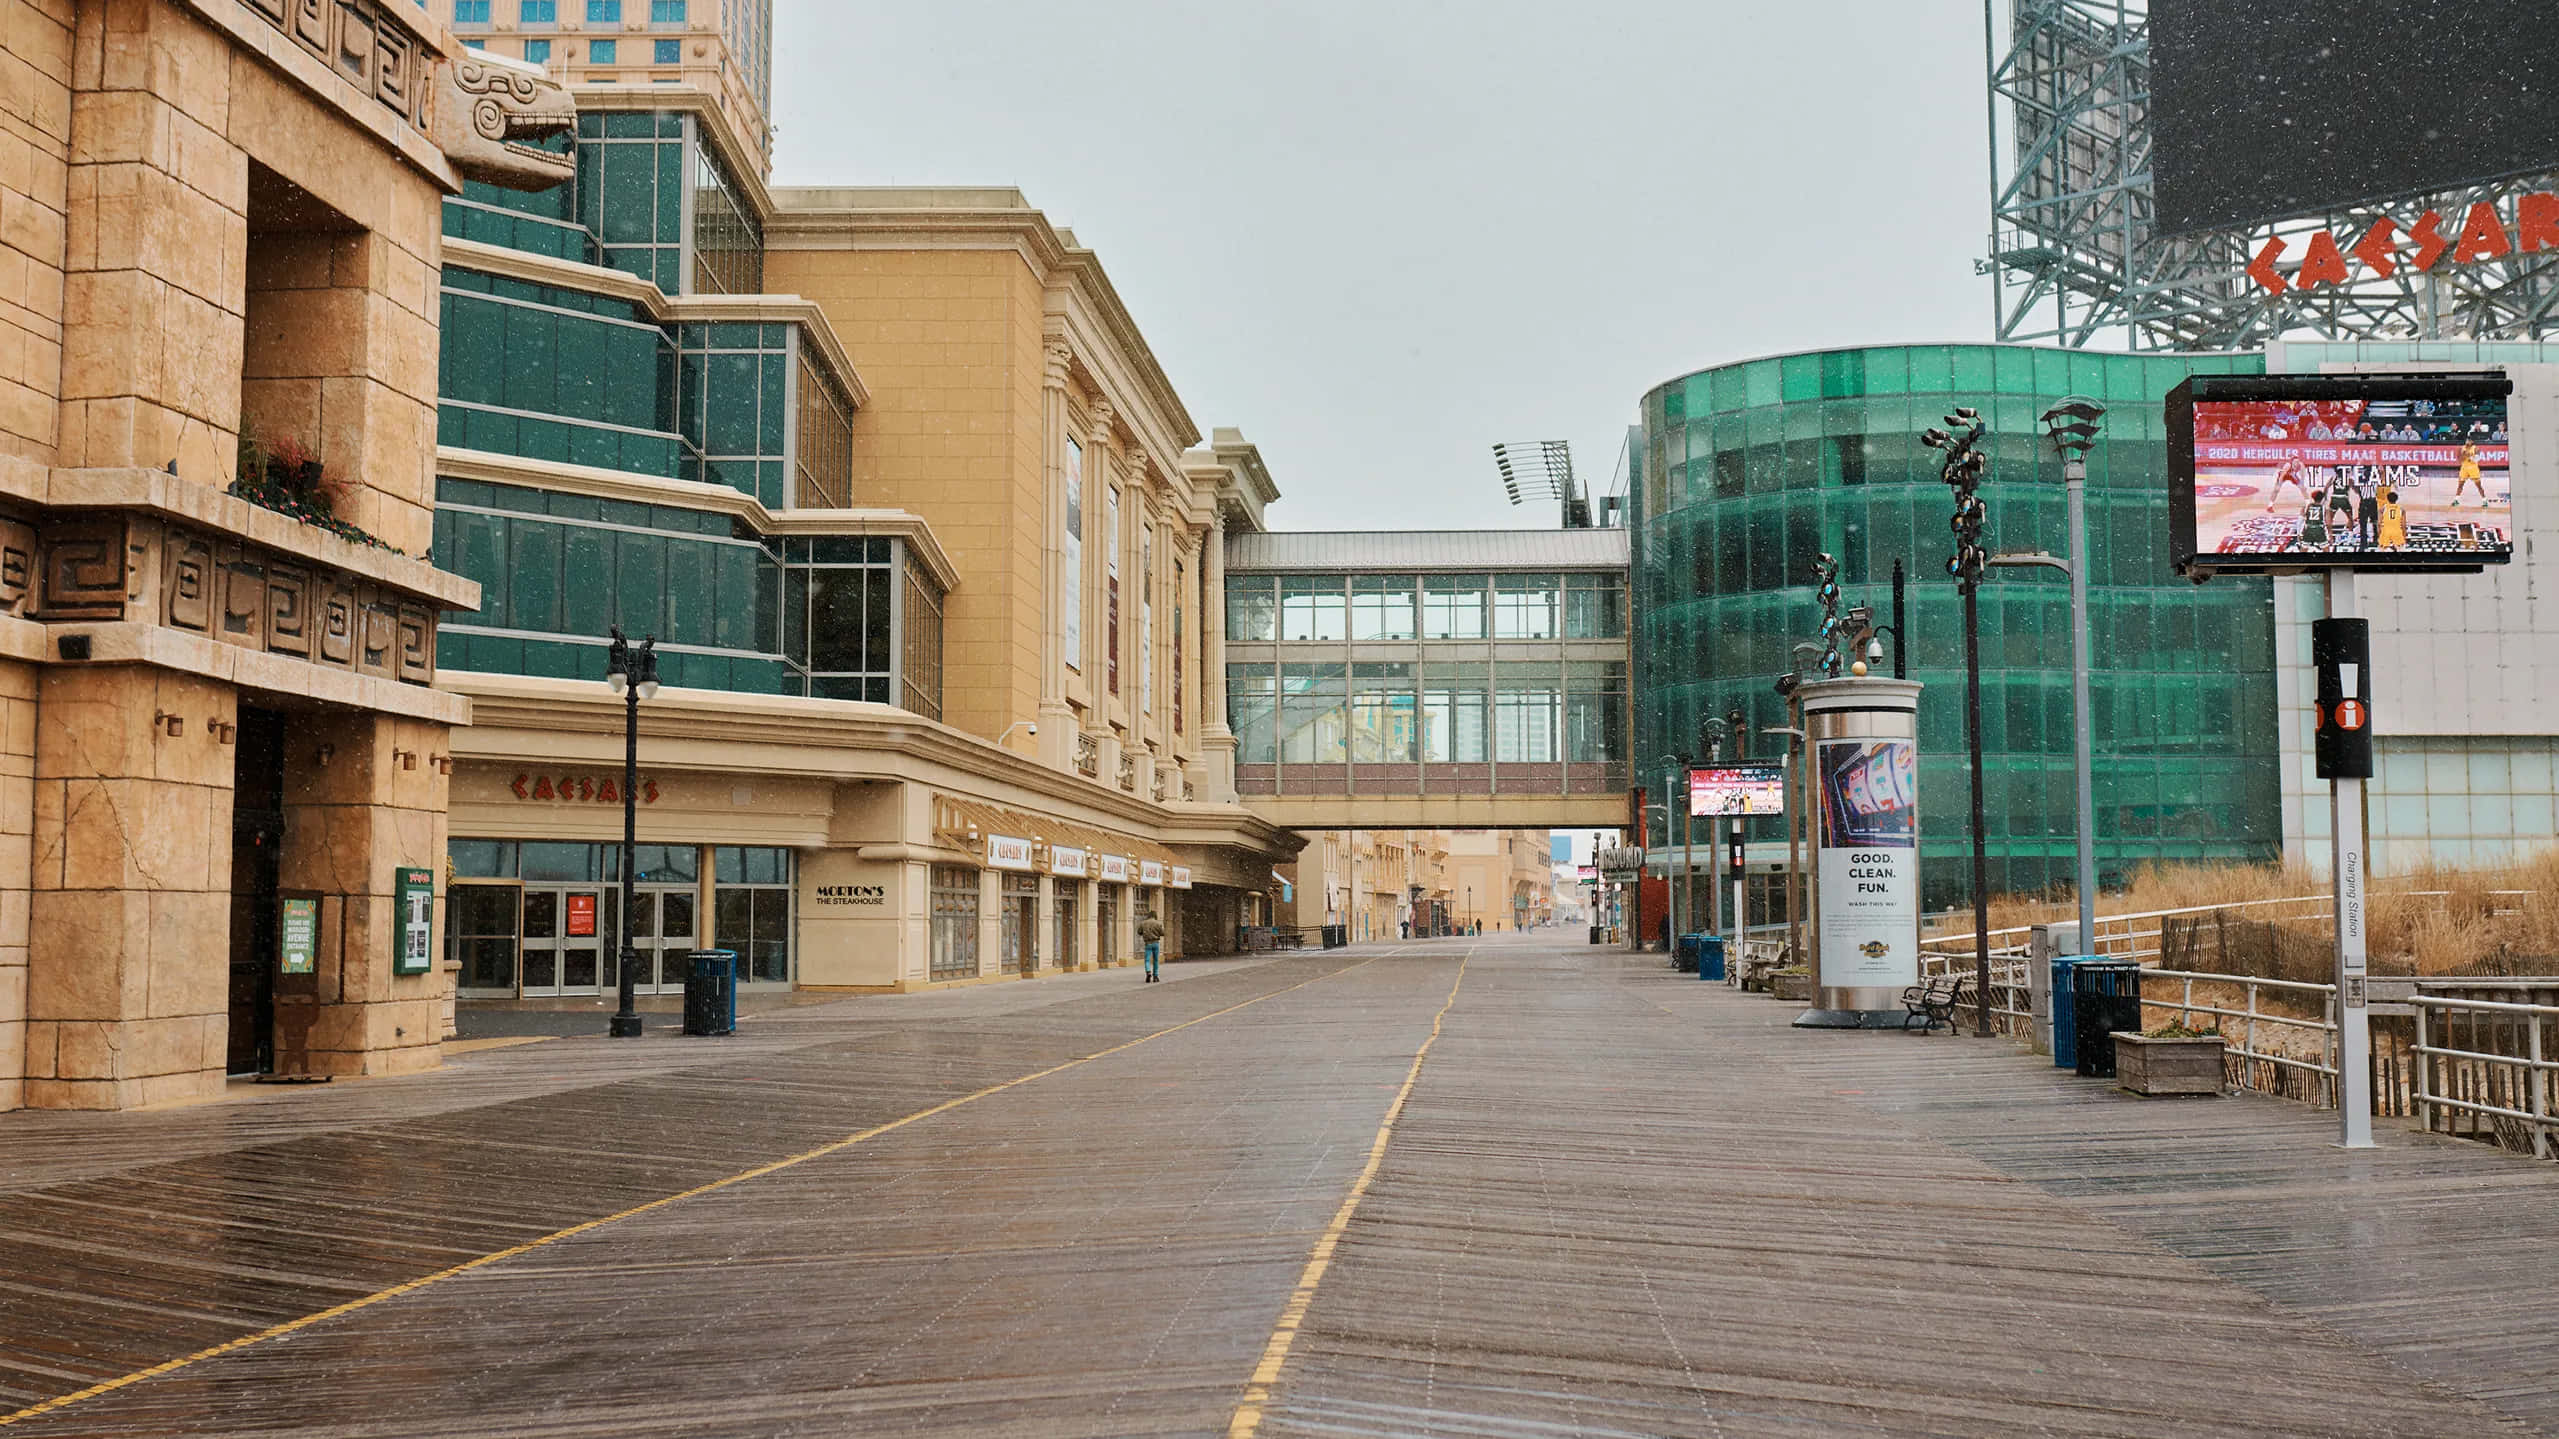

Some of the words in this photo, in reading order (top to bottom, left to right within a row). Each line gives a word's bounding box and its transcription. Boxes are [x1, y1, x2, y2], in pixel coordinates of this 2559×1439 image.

[2208, 447, 2239, 460] 2020
[2243, 447, 2299, 460] HERCULES
[2304, 448, 2337, 461] TIRES
[2381, 449, 2457, 462] BASKETBALL
[2336, 464, 2421, 488] TEAMS
[1851, 854, 1894, 864] GOOD.
[1848, 868, 1897, 878] CLEAN.
[2345, 851, 2358, 899] Charging
[816, 885, 885, 897] MORTON'S
[1858, 882, 1889, 893] FUN.
[816, 897, 832, 905] THE
[832, 897, 885, 905] STEAKHOUSE
[2348, 901, 2359, 938] Station
